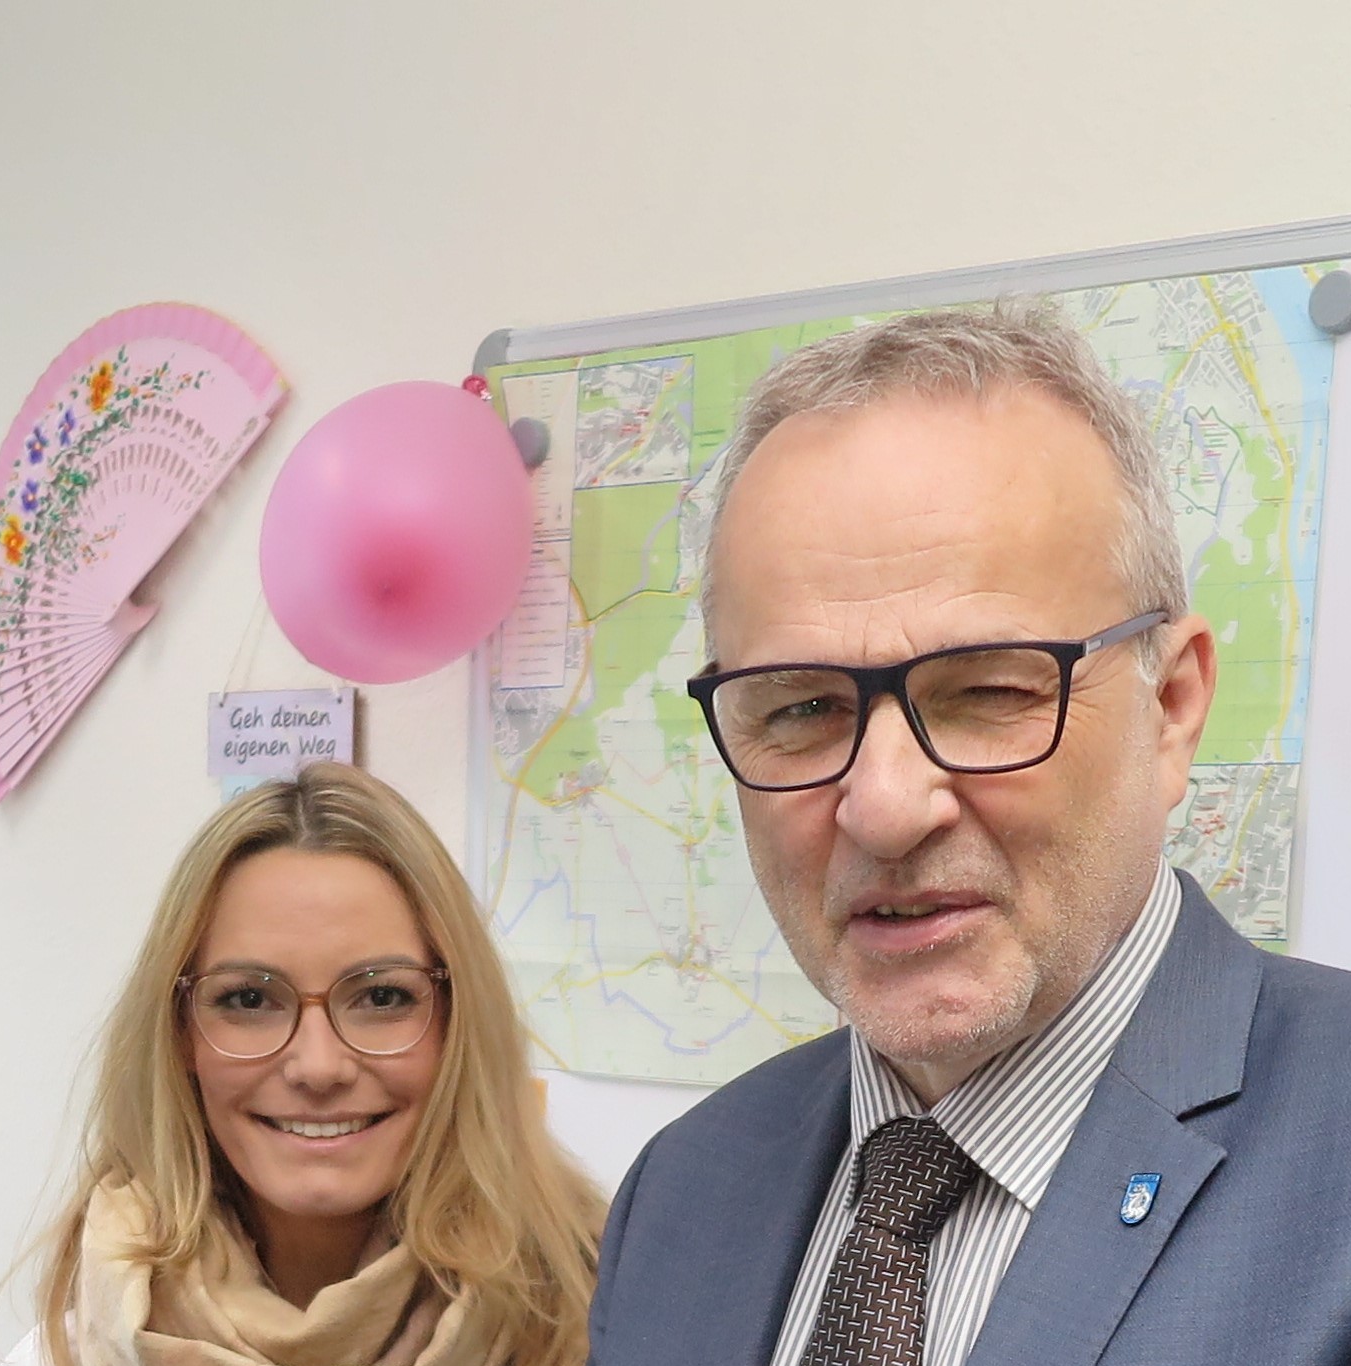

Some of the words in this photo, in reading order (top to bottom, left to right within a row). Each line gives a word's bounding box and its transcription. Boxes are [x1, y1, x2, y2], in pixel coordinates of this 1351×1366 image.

[230, 706, 264, 730] Geh
[271, 704, 332, 728] deinen
[223, 735, 291, 765] eigenen
[299, 735, 337, 760] Weg
